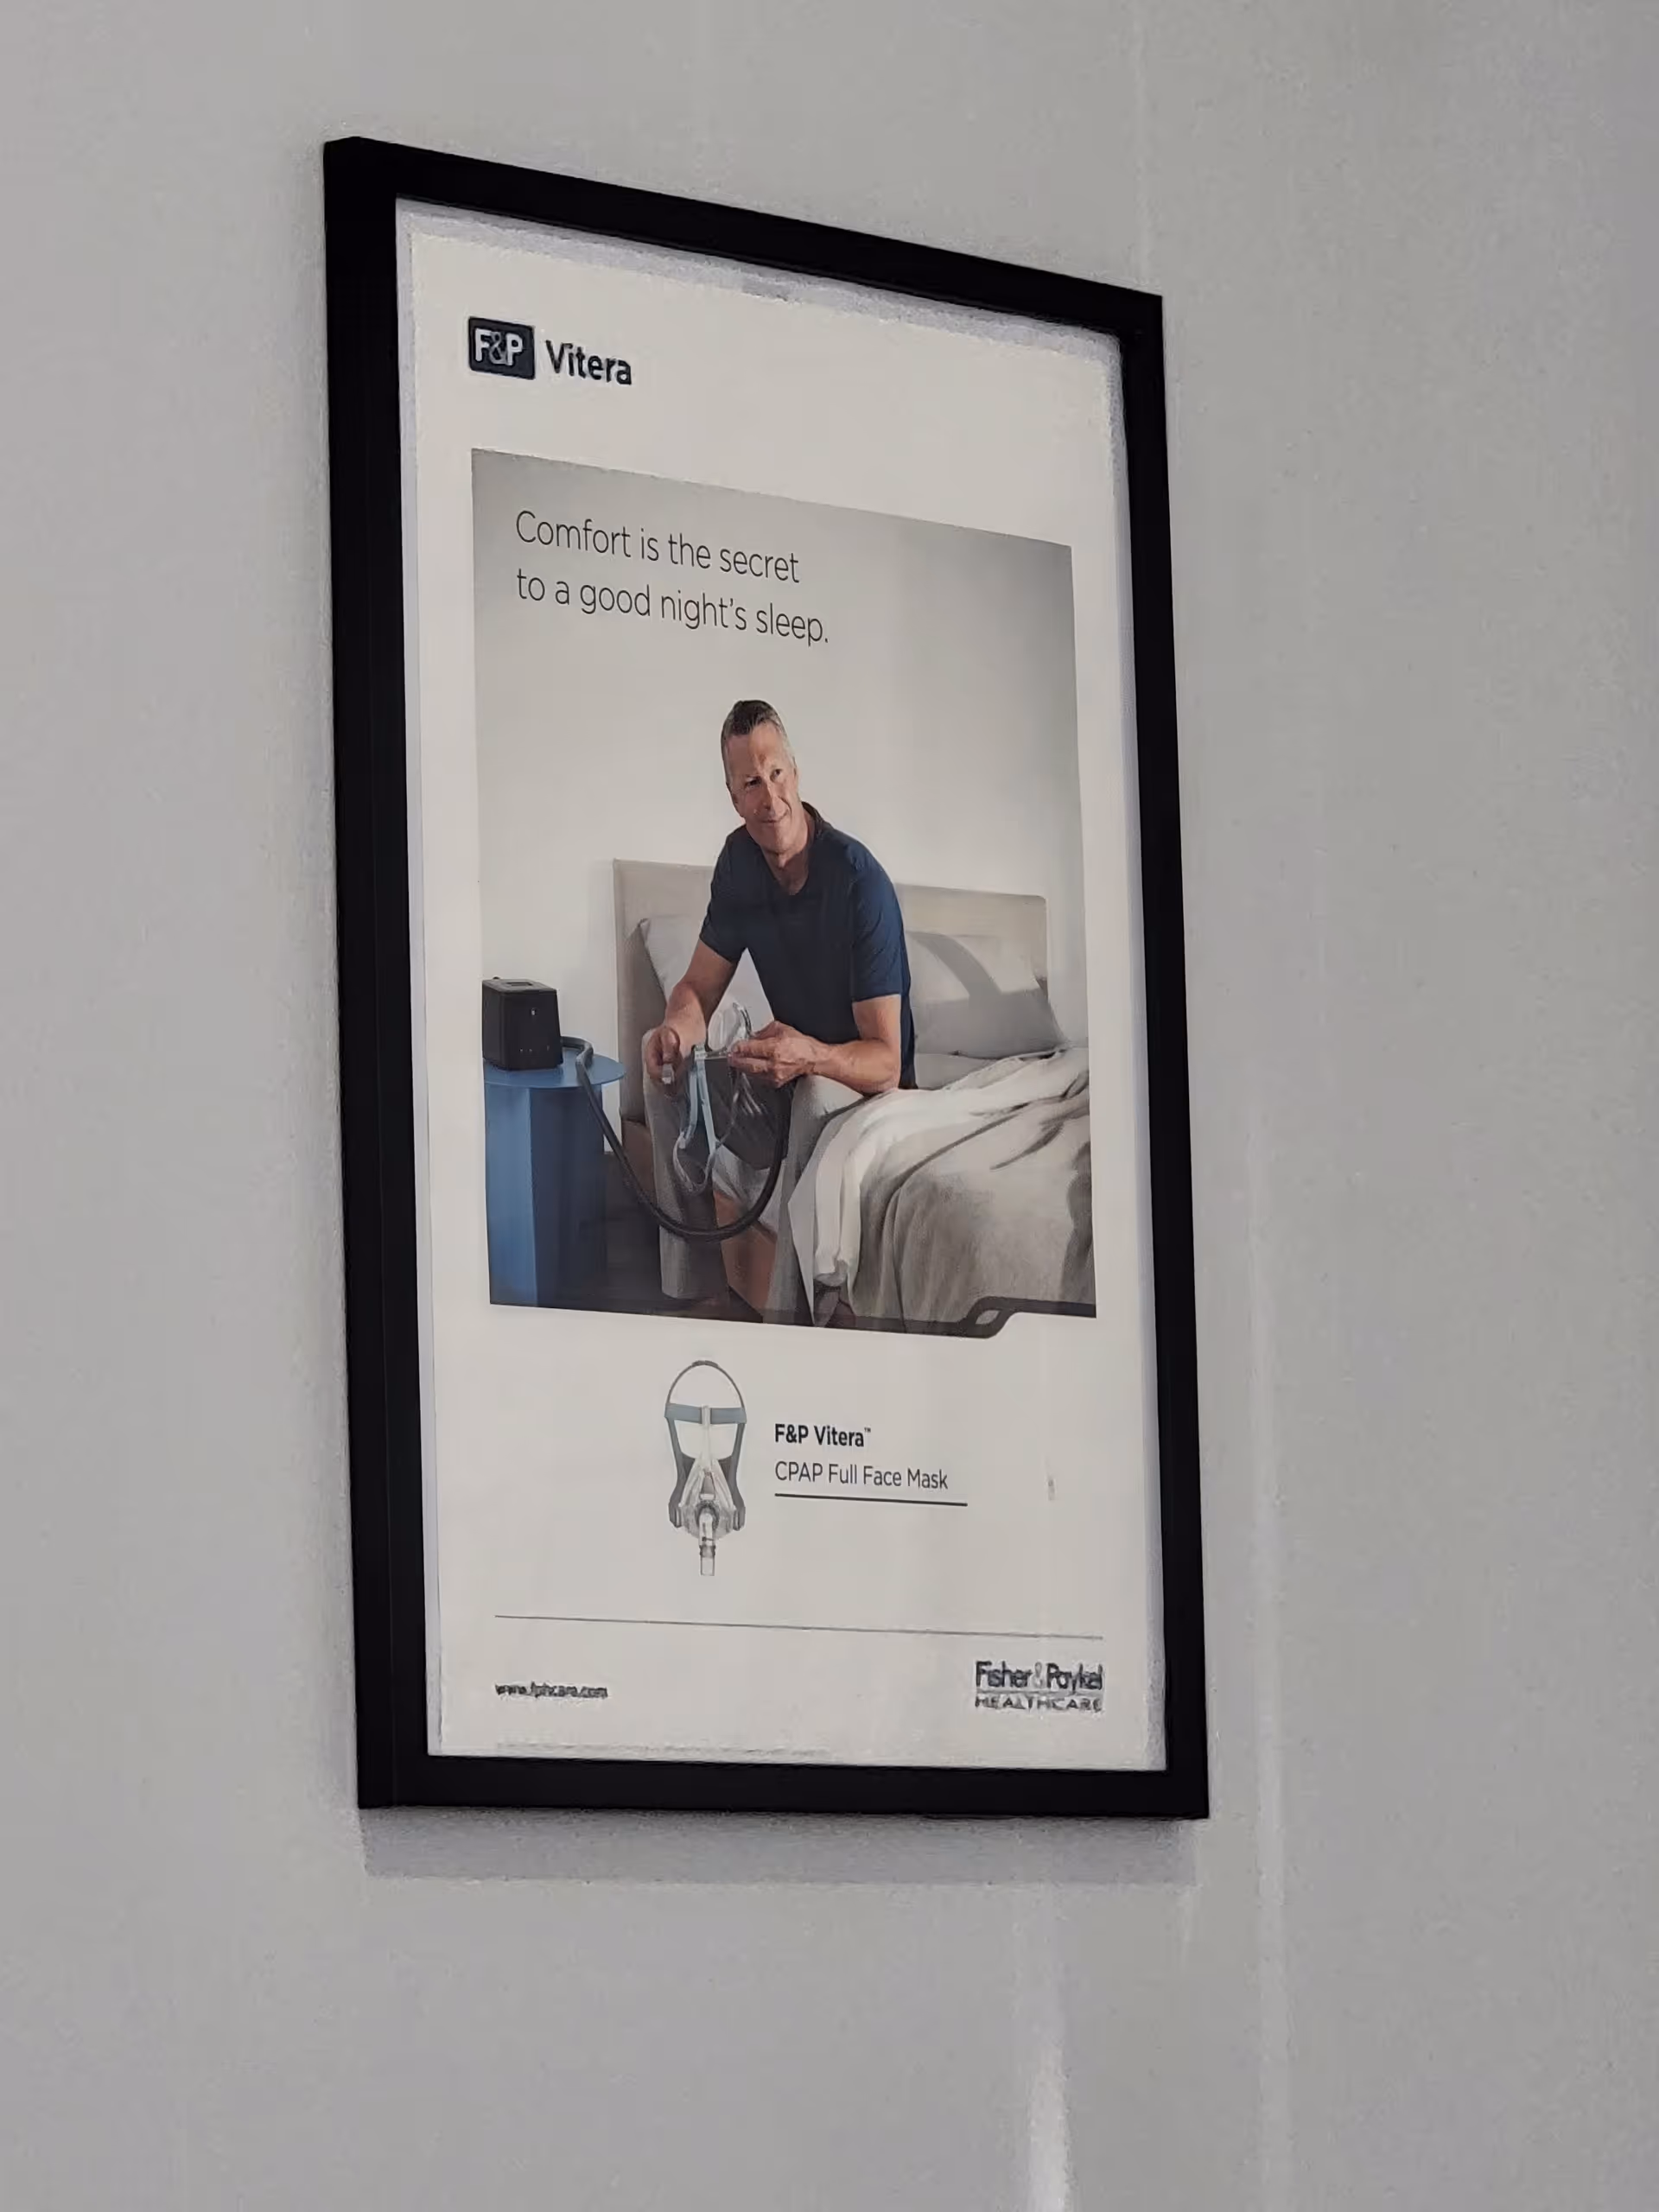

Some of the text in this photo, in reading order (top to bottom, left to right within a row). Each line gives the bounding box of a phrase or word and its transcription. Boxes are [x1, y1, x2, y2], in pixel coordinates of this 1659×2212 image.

[474, 327, 632, 385] F&P Vitera
[516, 510, 800, 583] Comfort is the secret
[516, 568, 546, 601] to
[554, 581, 570, 605] a
[579, 584, 651, 615] good
[756, 602, 830, 647] sleep.
[774, 1423, 809, 1444] F&P
[774, 1461, 949, 1490] CPAP Full Face Mask
